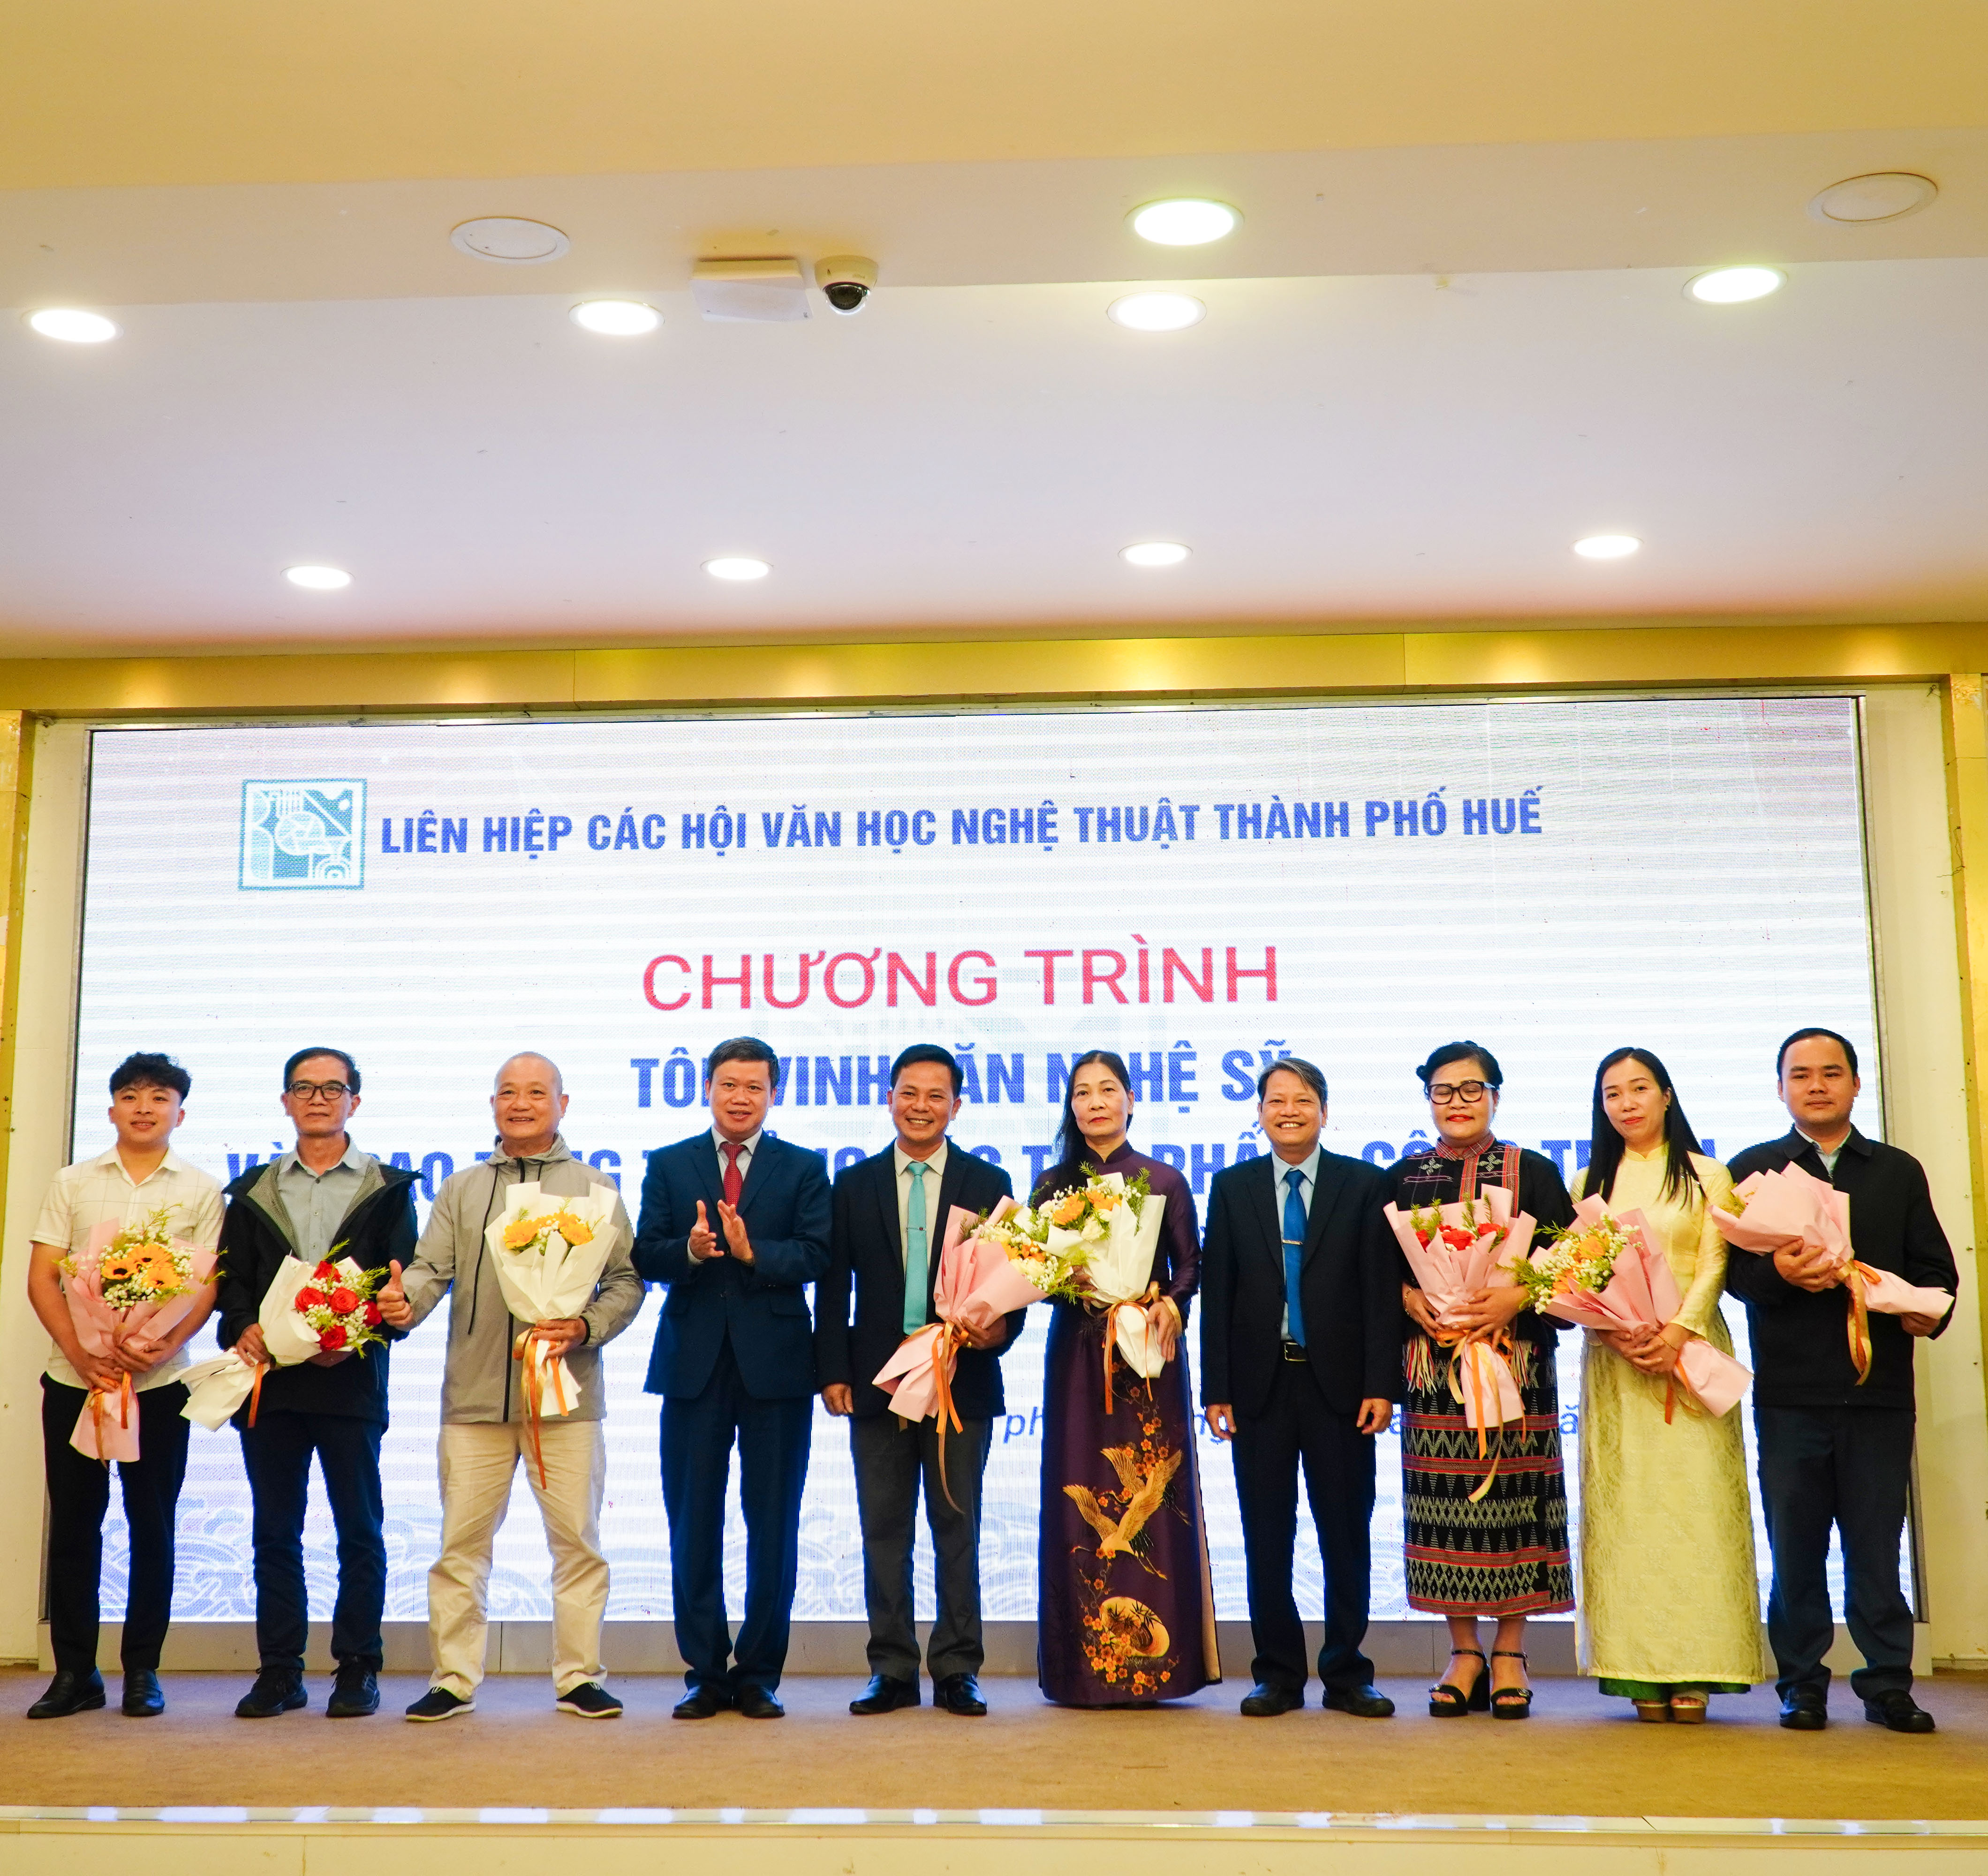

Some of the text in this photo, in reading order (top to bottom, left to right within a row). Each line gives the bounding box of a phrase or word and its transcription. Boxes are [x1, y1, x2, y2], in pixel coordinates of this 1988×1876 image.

[382, 786, 1542, 859] LIÊN HIỆP CÁC HỘI VĂN HỌC NGHỆ THUẬT THÀNH PHỐ HUẾ
[643, 934, 1277, 1011] CHƯƠNG TRÌNH
[953, 1043, 1025, 1104] ĂN
[1046, 1039, 1199, 1113] NHỆ
